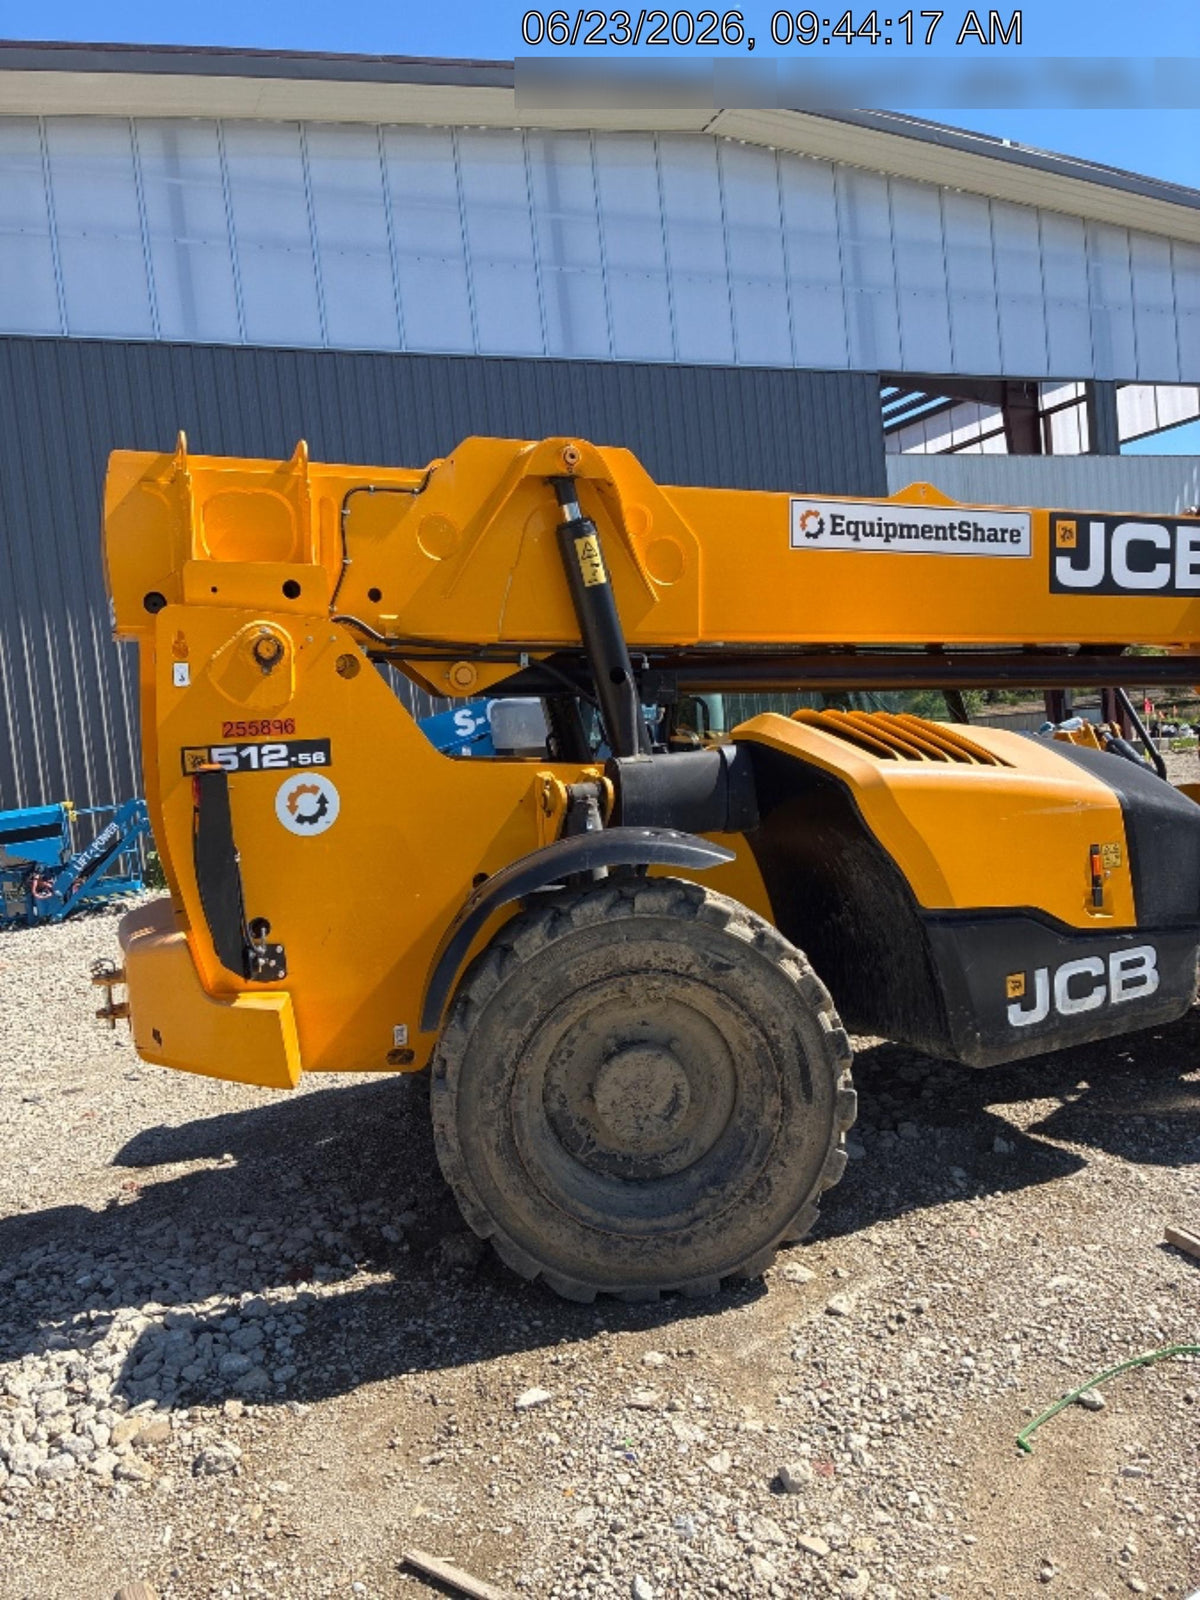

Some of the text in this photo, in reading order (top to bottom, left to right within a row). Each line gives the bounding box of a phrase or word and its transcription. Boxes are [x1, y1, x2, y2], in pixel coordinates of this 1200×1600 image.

[829, 514, 1022, 544] EquipmentShare
[222, 718, 296, 738] 255896
[210, 744, 326, 770] 512-56
[1007, 945, 1160, 1027] JCB
